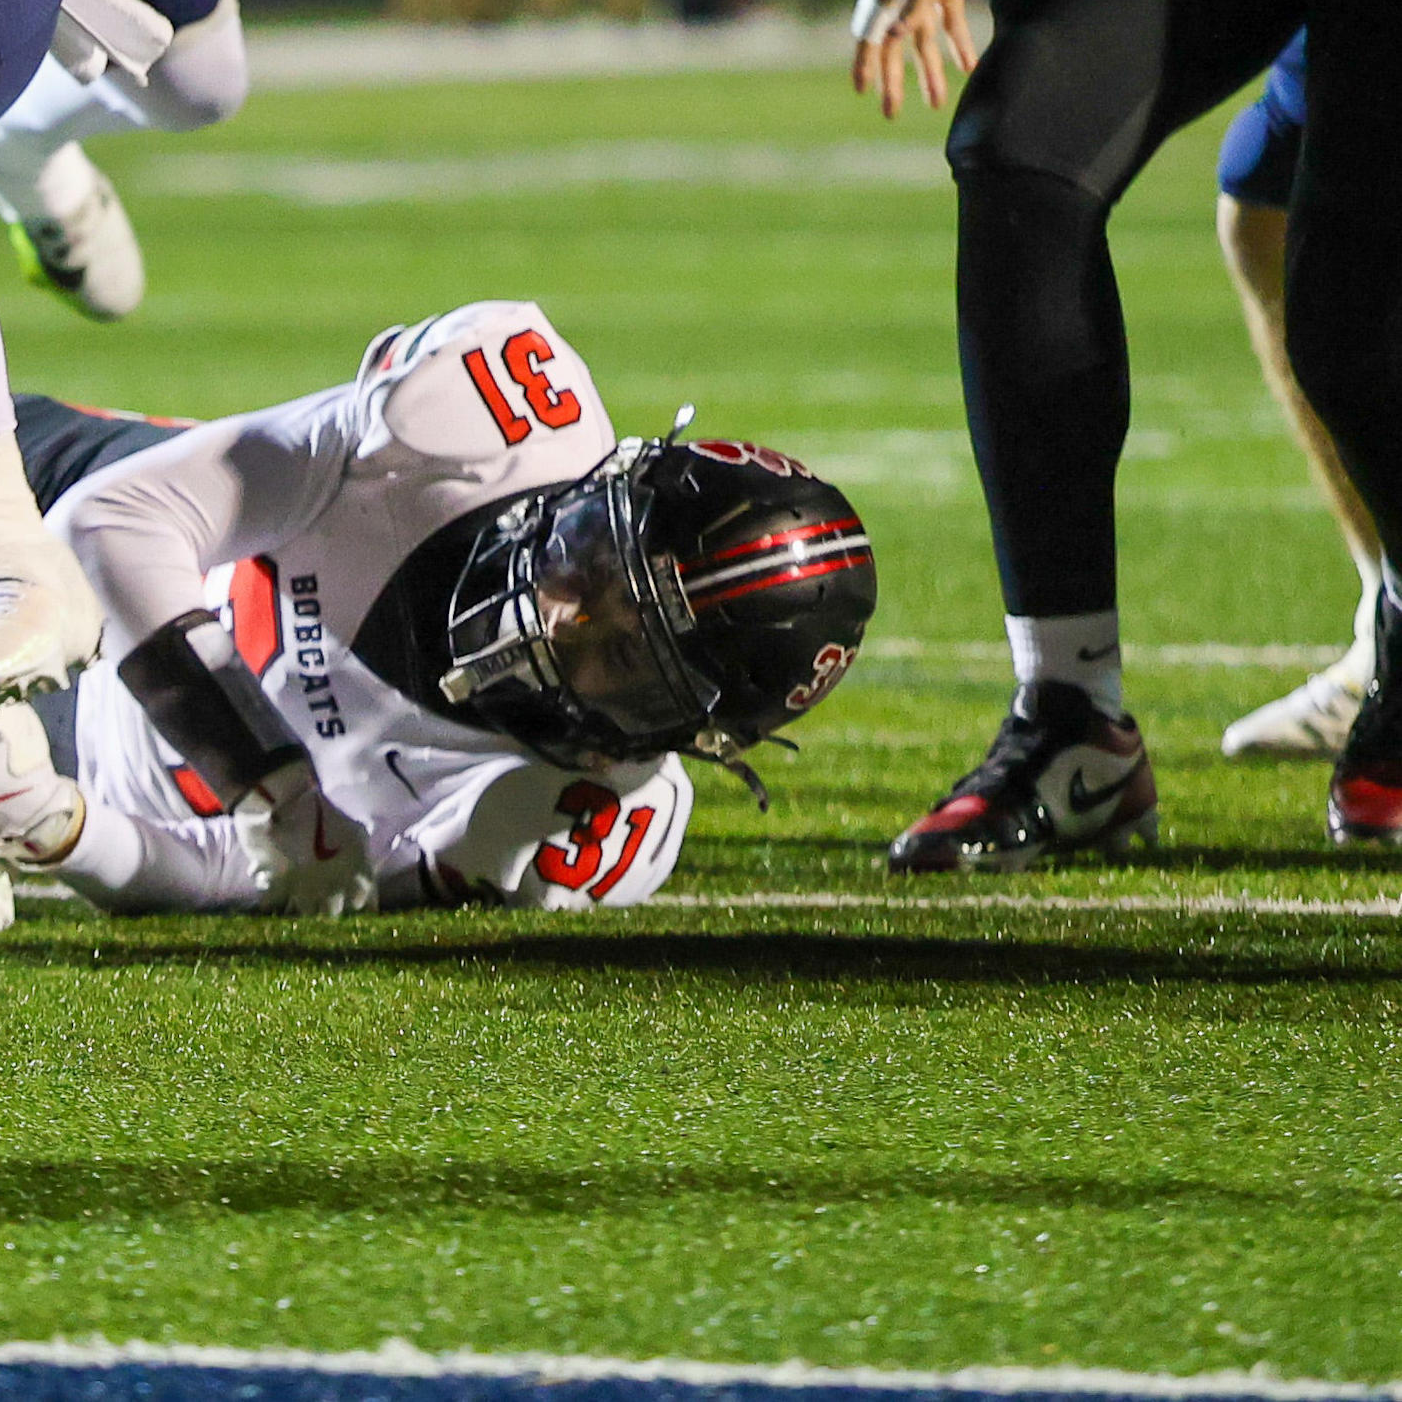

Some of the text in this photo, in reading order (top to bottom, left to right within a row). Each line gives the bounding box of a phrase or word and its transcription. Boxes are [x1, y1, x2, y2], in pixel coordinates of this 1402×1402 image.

[461, 328, 582, 446] 31
[288, 572, 348, 741] BOBCATS
[536, 780, 655, 900] 31
